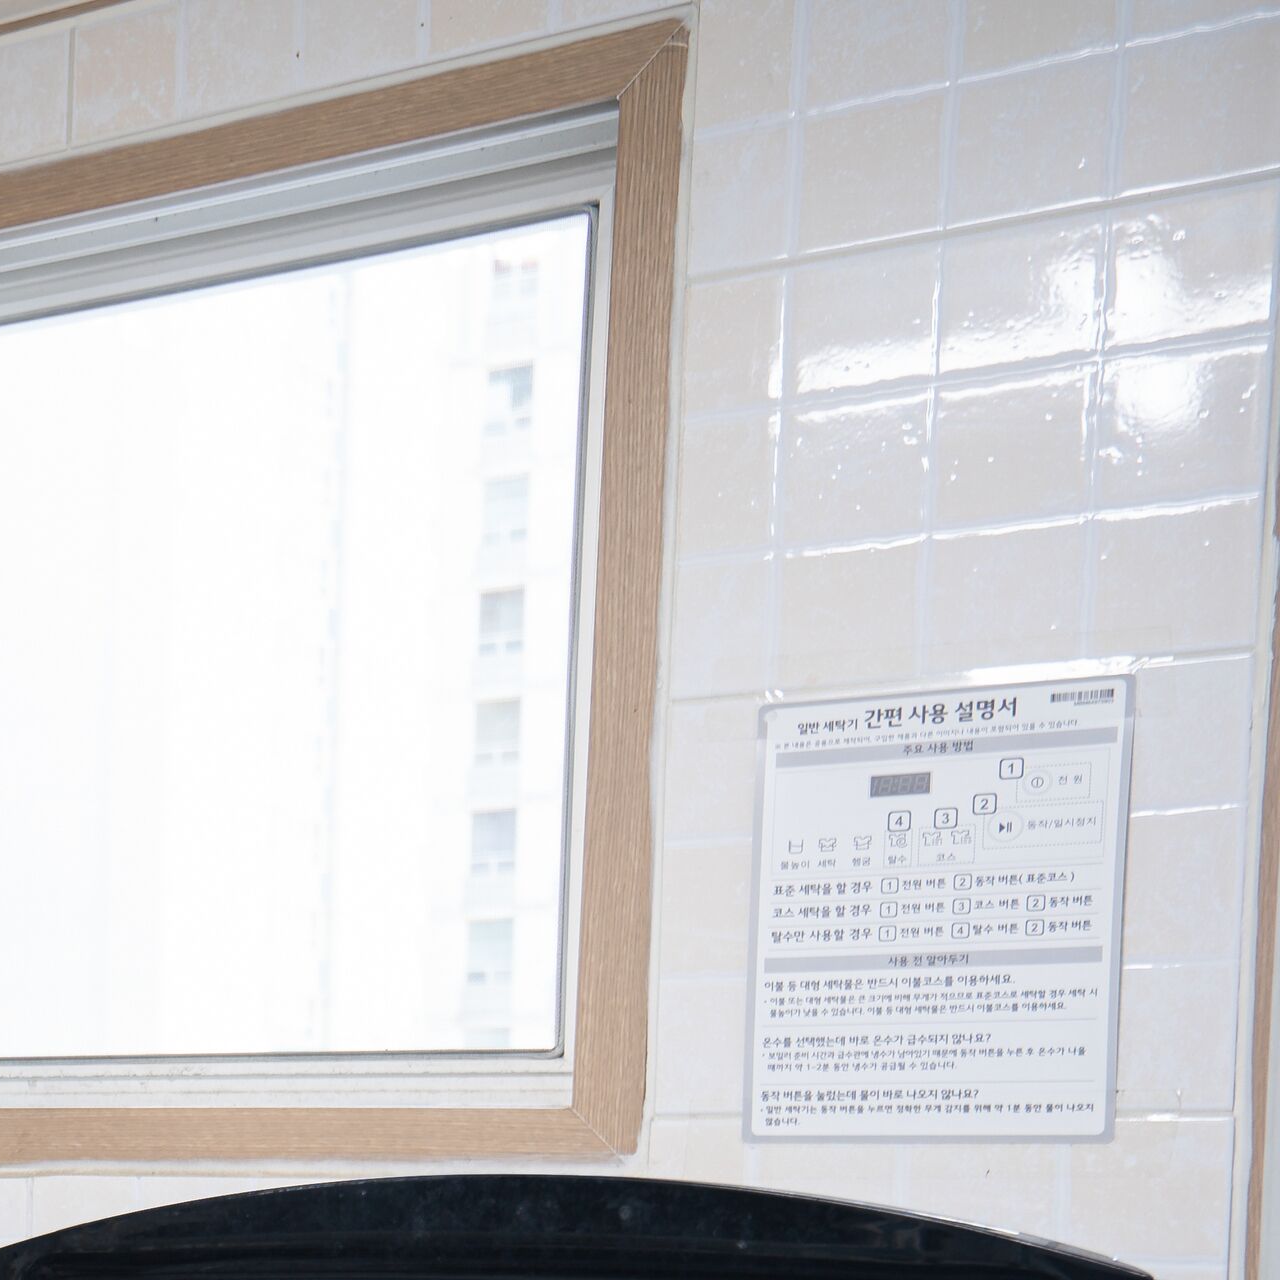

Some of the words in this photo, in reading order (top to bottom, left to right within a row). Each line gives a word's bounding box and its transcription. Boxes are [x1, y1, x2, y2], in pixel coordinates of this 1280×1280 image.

[797, 721, 820, 735] 일반
[823, 718, 858, 733] 세탁기
[864, 706, 903, 729] 간편
[908, 703, 948, 724] 사용
[955, 697, 1018, 723] 설명서
[902, 743, 923, 756] 주요
[927, 741, 949, 753] 사용
[952, 739, 974, 752] 방법
[817, 859, 836, 868] 세탁
[773, 885, 796, 897] 표준
[799, 883, 832, 896] 세탁을
[836, 882, 847, 895] 할
[851, 881, 872, 894] 경우
[902, 879, 922, 890] 전원
[926, 878, 946, 889] 버튼
[975, 876, 995, 888] 동작
[772, 907, 795, 918] 코스
[798, 906, 831, 918] 세탁을
[835, 905, 845, 918] 할
[850, 904, 872, 917] 경우
[901, 903, 921, 914] 전원
[925, 901, 945, 913] 버튼
[974, 900, 994, 909] 코스
[998, 898, 1020, 910] 버튼
[1048, 896, 1069, 908] 동작
[1072, 895, 1093, 906] 버튼
[771, 930, 805, 943] 탈수만
[810, 928, 845, 942] 사용할
[849, 927, 872, 940] 경우
[900, 926, 920, 938] 전원
[923, 926, 944, 937] 버튼
[973, 924, 994, 936] 탈수
[997, 922, 1019, 934] 버튼
[1047, 921, 1068, 933] 동작
[1071, 920, 1092, 931] 버튼
[888, 954, 908, 967] 사용
[913, 955, 923, 965] 전
[926, 953, 969, 967] 알아두기
[764, 980, 784, 992] 이불
[787, 980, 796, 992] 등
[800, 979, 820, 991] 대형
[823, 978, 863, 991] 세탁물은
[867, 977, 899, 990] 반드시
[901, 975, 953, 989] 이불코스를
[957, 974, 1016, 987] 이용하세요.
[867, 1006, 882, 1016] 이불
[895, 1005, 912, 1015] 대형
[914, 1004, 946, 1014] 세탁물은
[949, 1004, 974, 1014] 반드시
[763, 1036, 792, 1049] 온수를
[796, 1035, 846, 1048] 선택했는데
[849, 1034, 870, 1046] 바로
[873, 1034, 904, 1046] 온수가
[907, 1033, 949, 1046] 급수되지
[952, 1032, 991, 1045] 않나요?
[761, 1090, 780, 1102] 동작
[783, 1090, 814, 1102] 버튼을
[816, 1089, 856, 1102] 눌렀는데
[860, 1089, 880, 1101] 물이
[883, 1089, 904, 1100] 바로
[907, 1088, 938, 1100] 나오지
[941, 1088, 979, 1101] 않나요?
